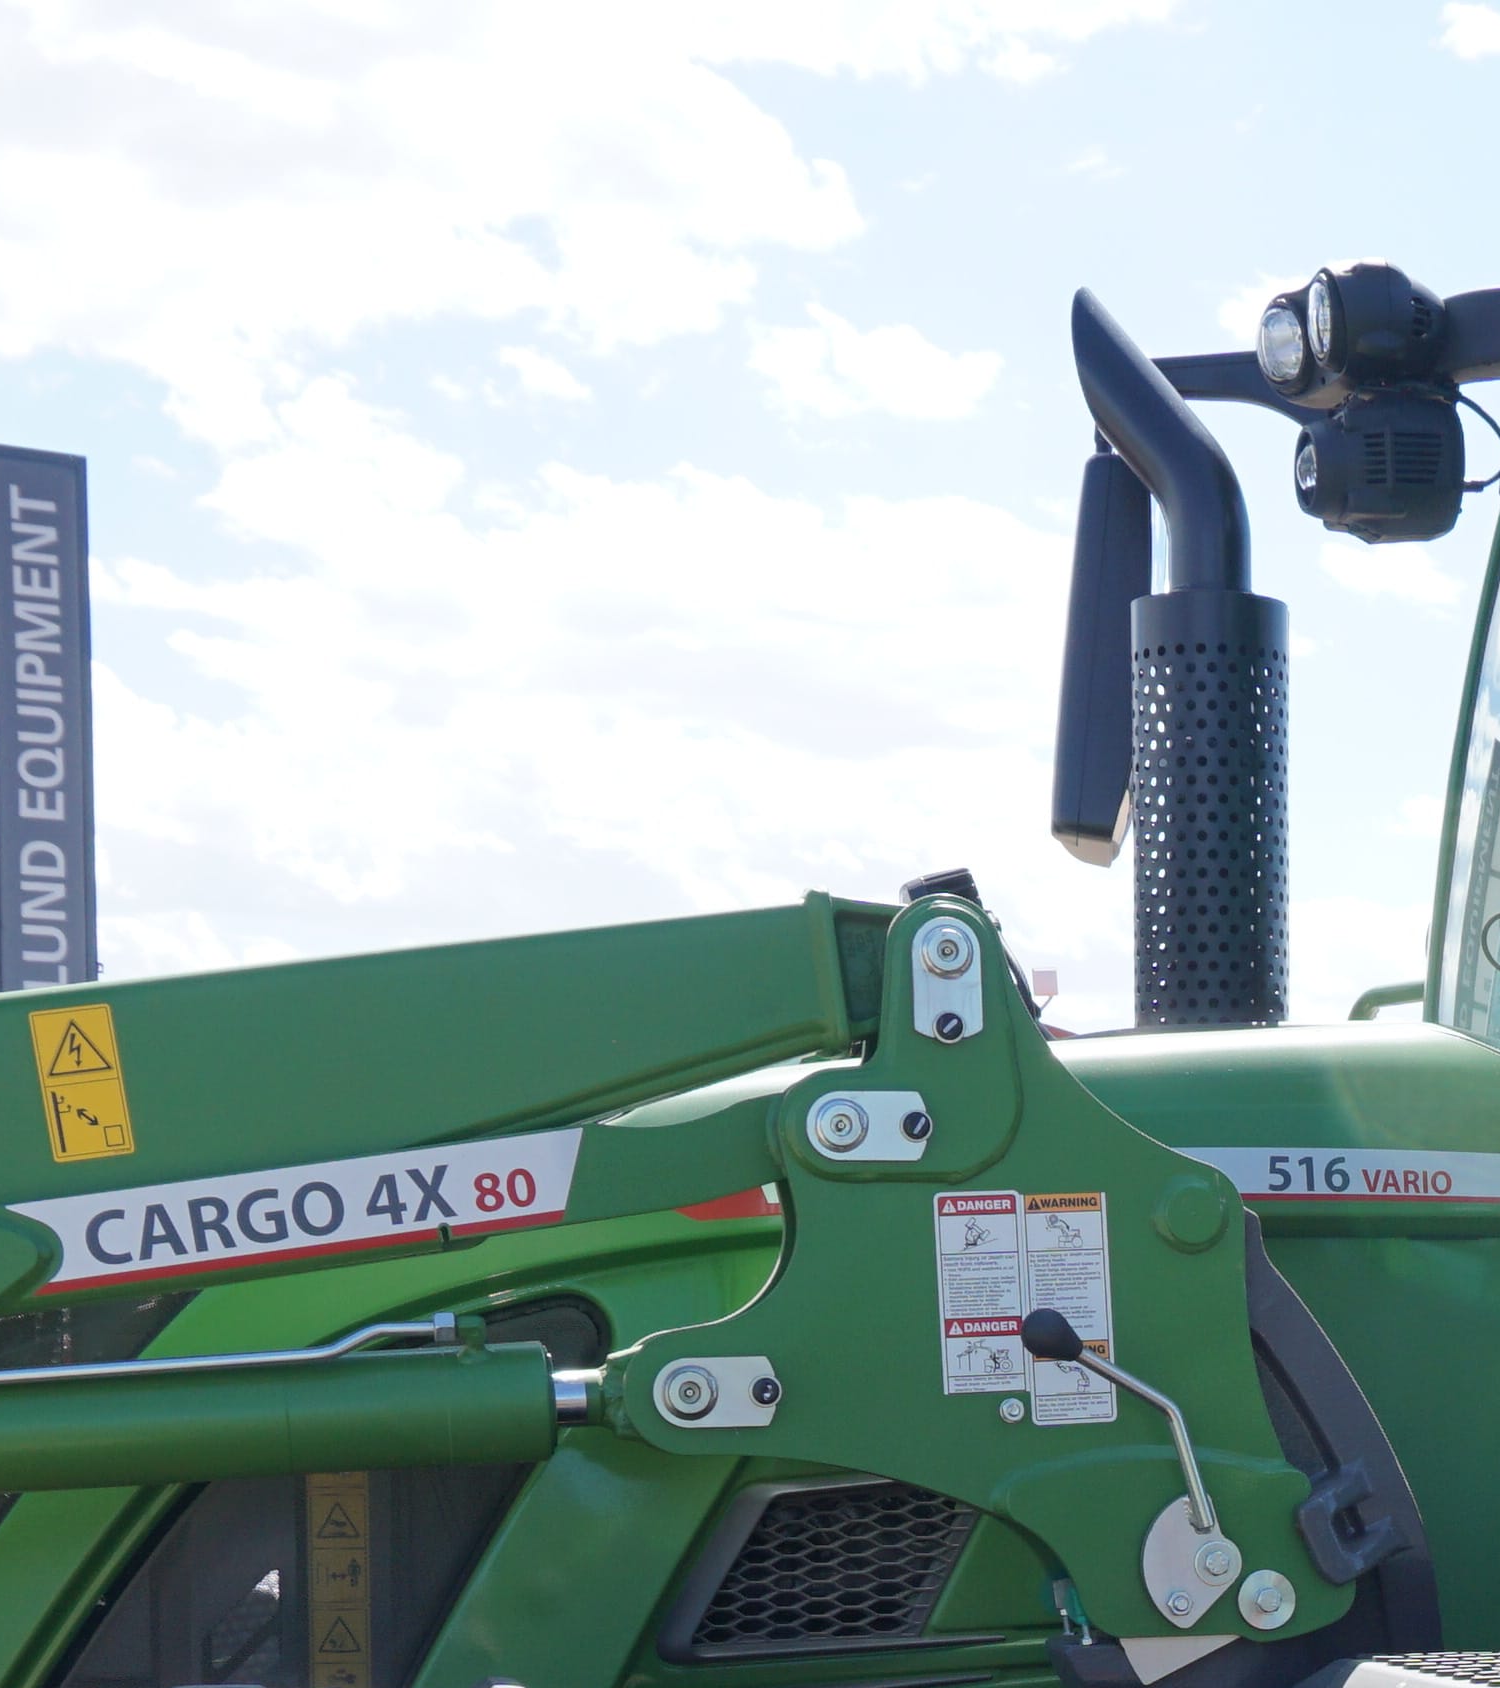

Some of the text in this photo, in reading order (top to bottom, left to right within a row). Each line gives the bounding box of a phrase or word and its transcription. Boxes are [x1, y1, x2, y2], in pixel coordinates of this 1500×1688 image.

[8, 483, 66, 821] EQUIPMENT
[1269, 1156, 1452, 1194] 516 VARIO
[85, 1164, 537, 1264] CARGO 4X 80
[957, 1199, 1012, 1211] DANGER
[1041, 1197, 1098, 1208] WARNING
[963, 1321, 1018, 1333] DANGER
